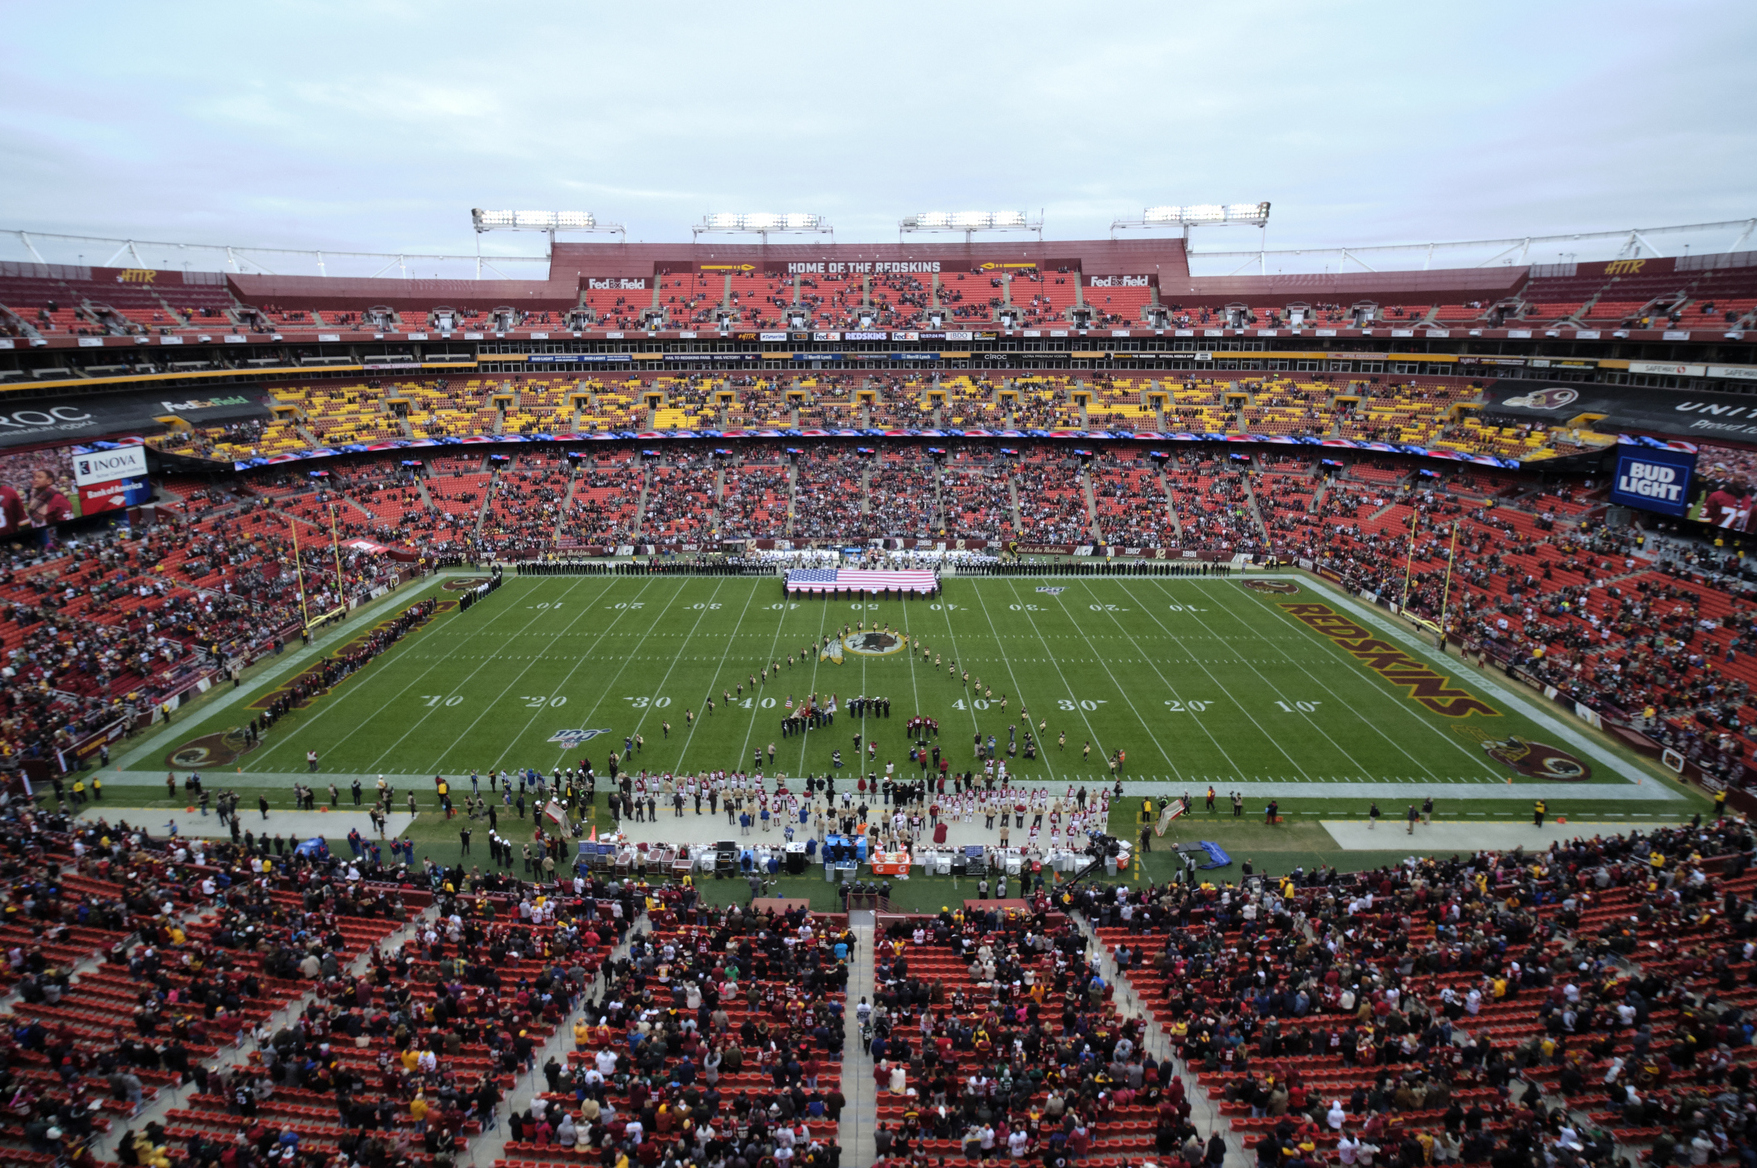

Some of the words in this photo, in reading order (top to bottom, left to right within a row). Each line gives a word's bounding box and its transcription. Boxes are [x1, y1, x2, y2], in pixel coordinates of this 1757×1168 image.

[788, 262, 825, 273] HOME
[829, 262, 844, 273] OF
[848, 262, 872, 273] THE
[876, 262, 940, 273] REDSKINS
[1604, 260, 1646, 274] HTTR
[121, 268, 157, 283] HTTR
[1091, 275, 1148, 287] FedExField
[589, 278, 645, 290] FedExField
[161, 396, 250, 412] FedExField
[55, 420, 98, 430] VODKA
[1690, 419, 1746, 432] Proud
[94, 455, 136, 471] INOVA
[1630, 462, 1676, 483] BUD
[87, 488, 107, 499] Bank
[107, 486, 114, 494] of
[114, 482, 144, 493] America
[1618, 476, 1682, 501] LIGHT
[1276, 602, 1503, 718] REDSKINS
[430, 694, 464, 707] 10
[524, 696, 568, 708] 20
[632, 696, 671, 708] 30
[738, 697, 776, 709] 40
[952, 699, 990, 711] 40
[1057, 699, 1098, 712] 30
[1164, 700, 1206, 712] 20
[1275, 700, 1316, 713] 10
